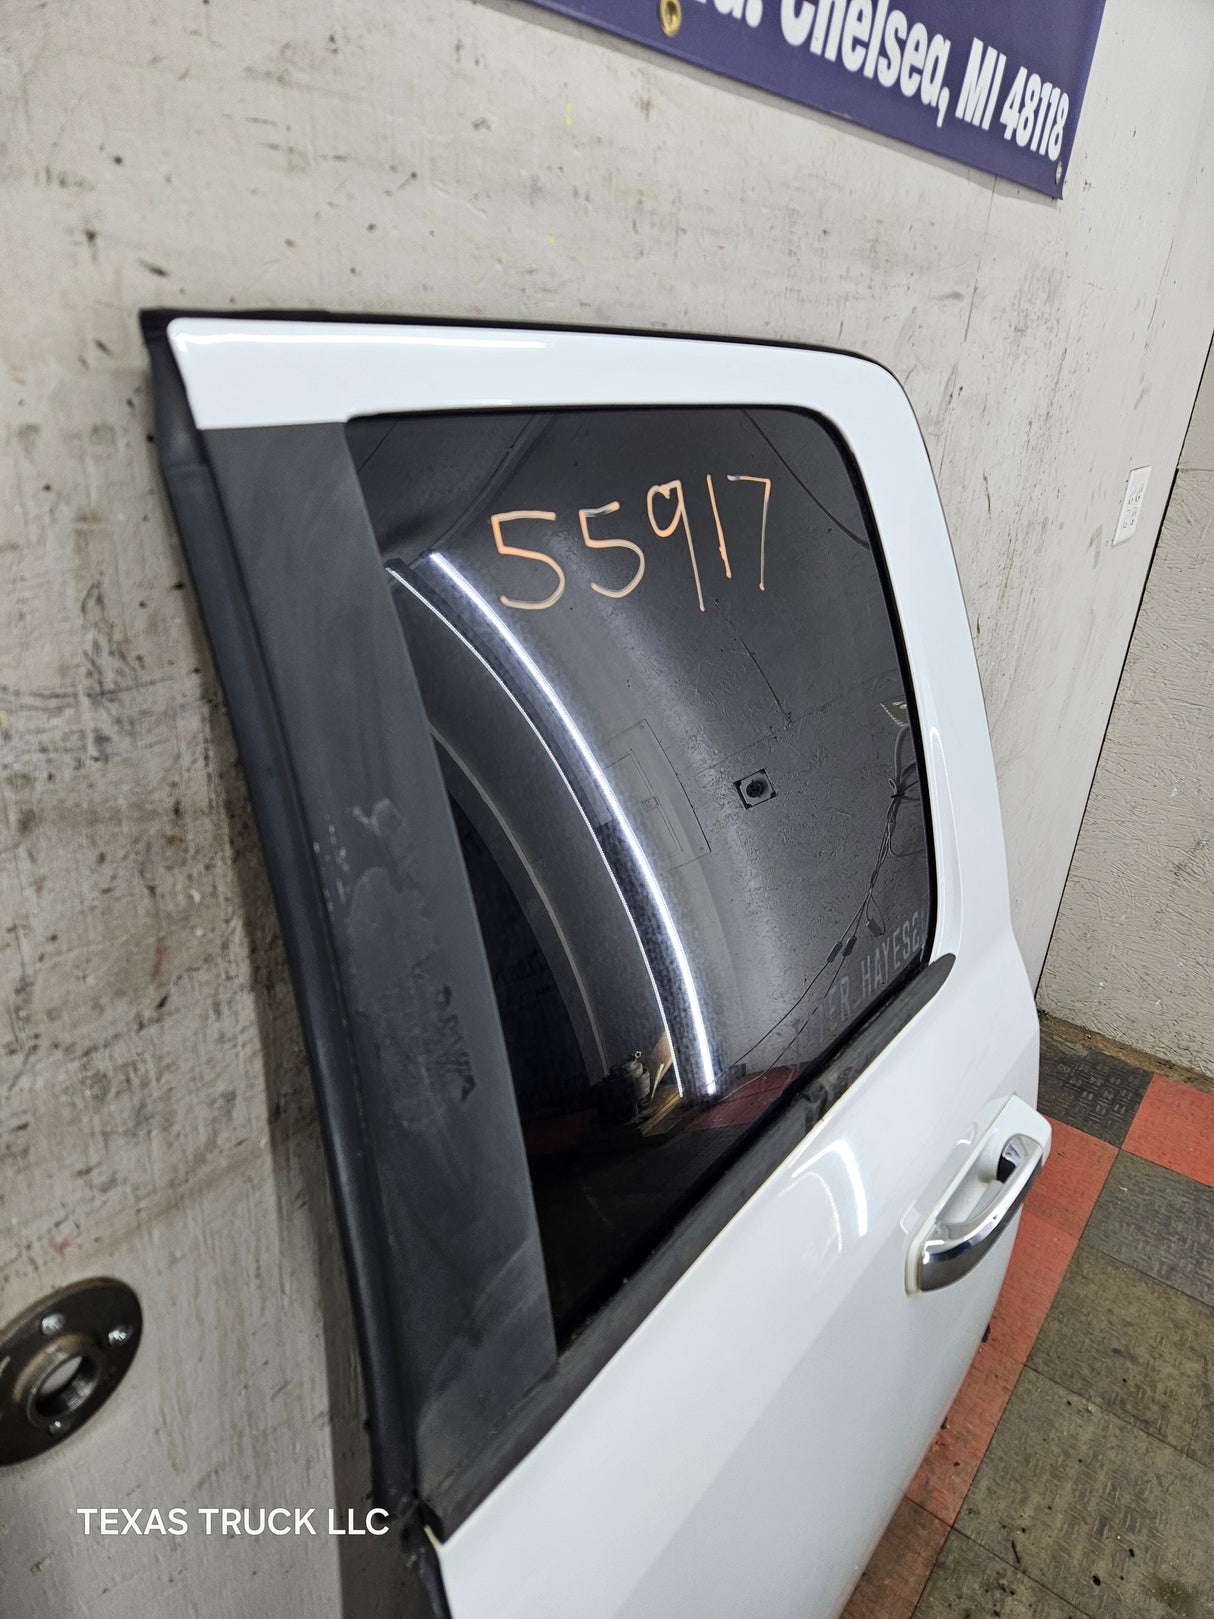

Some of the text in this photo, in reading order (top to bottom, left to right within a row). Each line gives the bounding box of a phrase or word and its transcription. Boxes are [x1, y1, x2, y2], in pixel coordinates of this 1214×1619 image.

[955, 36, 1007, 131] MI
[1000, 66, 1070, 161] 48118
[491, 474, 771, 612] 55917
